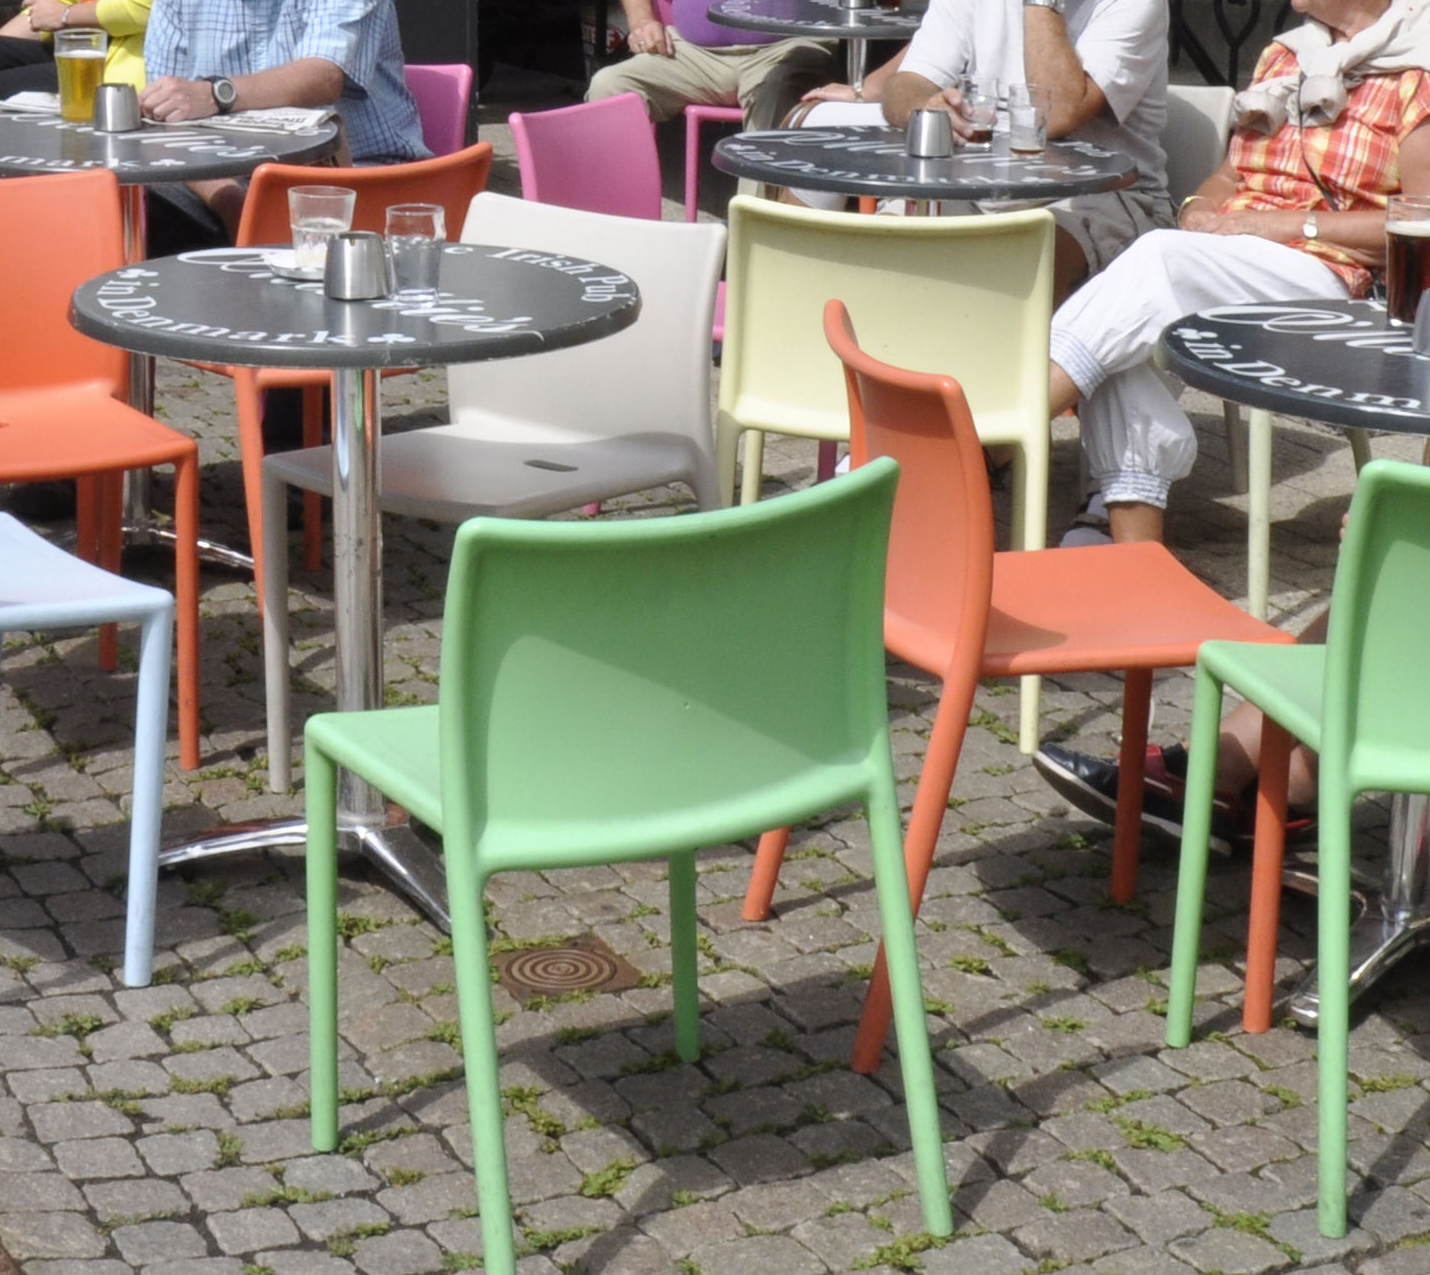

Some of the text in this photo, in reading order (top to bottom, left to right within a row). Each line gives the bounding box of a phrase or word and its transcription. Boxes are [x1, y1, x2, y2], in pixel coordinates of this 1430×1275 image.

[485, 247, 600, 276] Irish
[578, 274, 638, 305] Pub
[98, 296, 358, 347] Denmark
